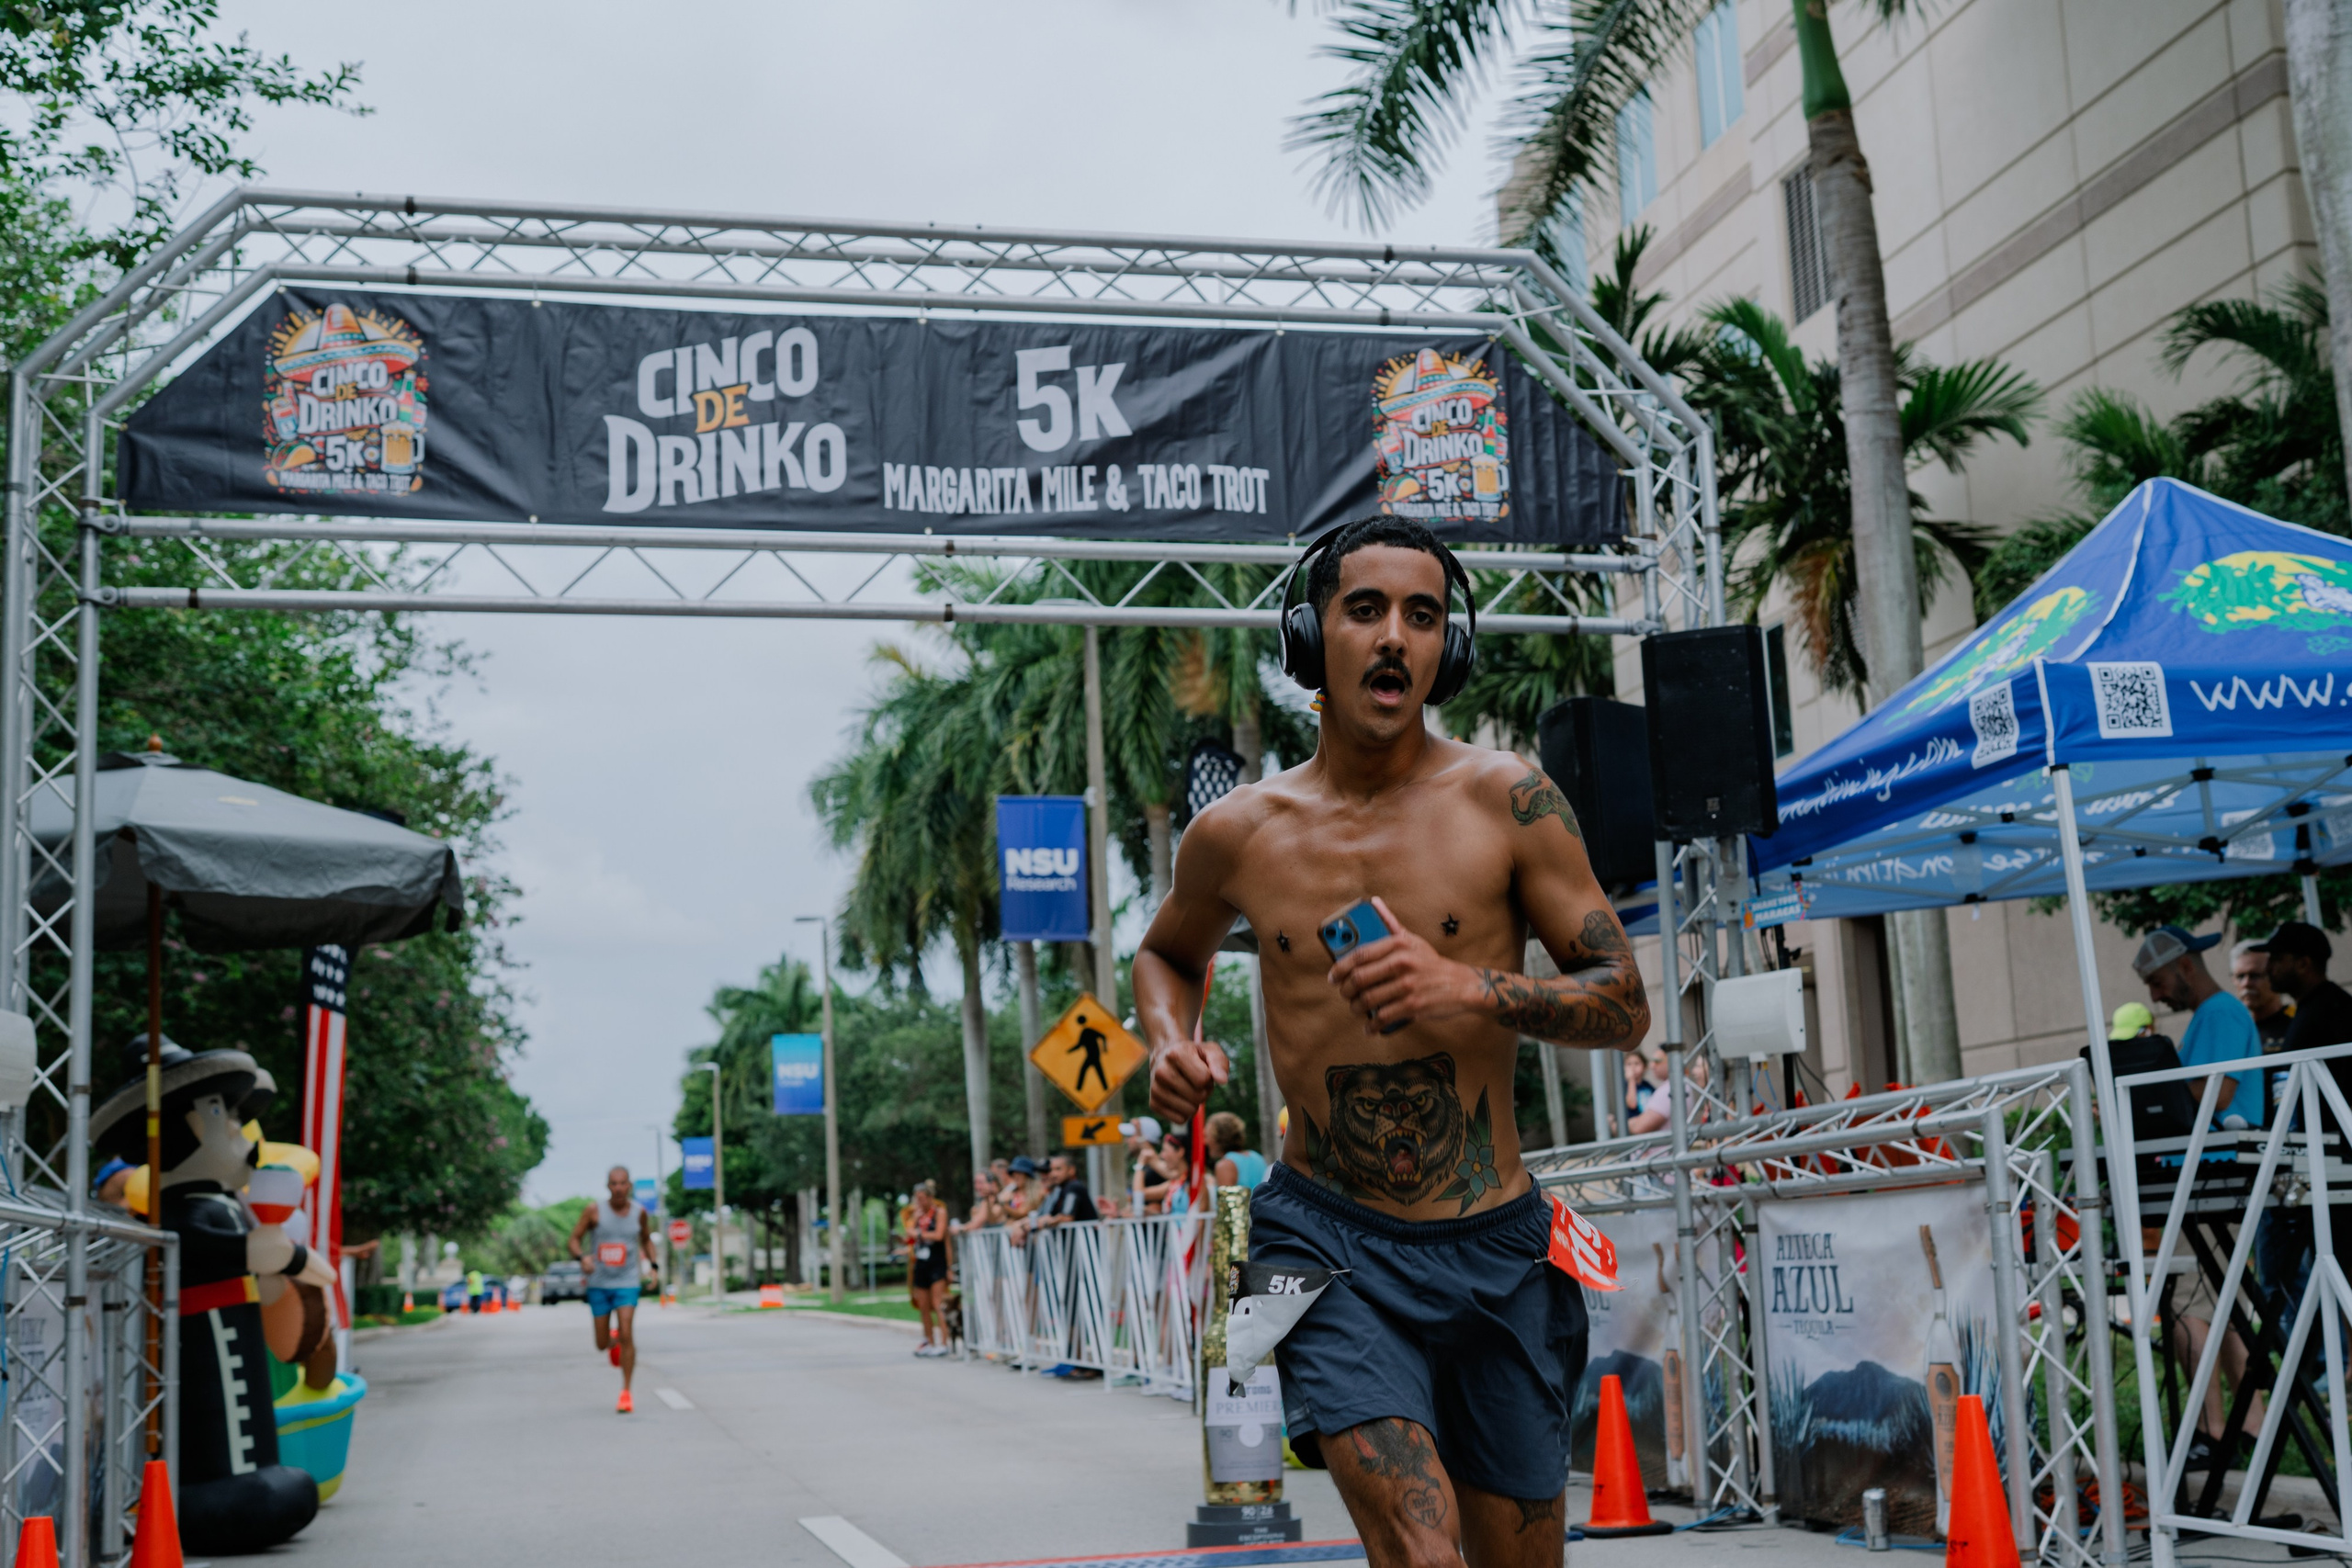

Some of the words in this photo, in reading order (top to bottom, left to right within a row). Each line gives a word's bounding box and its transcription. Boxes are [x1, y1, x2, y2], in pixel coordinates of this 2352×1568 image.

[311, 361, 389, 398] CINCO
[638, 326, 820, 419] CINCO
[335, 382, 358, 400] DE
[693, 383, 751, 434] DE
[1014, 344, 1134, 453] 5K
[298, 393, 398, 434] DRINKO
[1411, 398, 1473, 434] CINCO
[1431, 419, 1450, 436] DE
[325, 435, 366, 471] 5K
[601, 414, 848, 514] DRINKO
[1401, 430, 1485, 468] DRINKO
[883, 461, 1035, 514] MARGARITA
[1041, 465, 1099, 513] MILE
[1105, 464, 1131, 513] &
[1136, 463, 1203, 511] TACO
[1207, 465, 1271, 514] TROT
[1427, 468, 1462, 501] 5K
[1004, 847, 1080, 877] NSU
[1005, 875, 1078, 892] Research
[1776, 1233, 1835, 1261] AZTECA
[1268, 1275, 1306, 1295] 5K
[1771, 1265, 1854, 1314] AZUL
